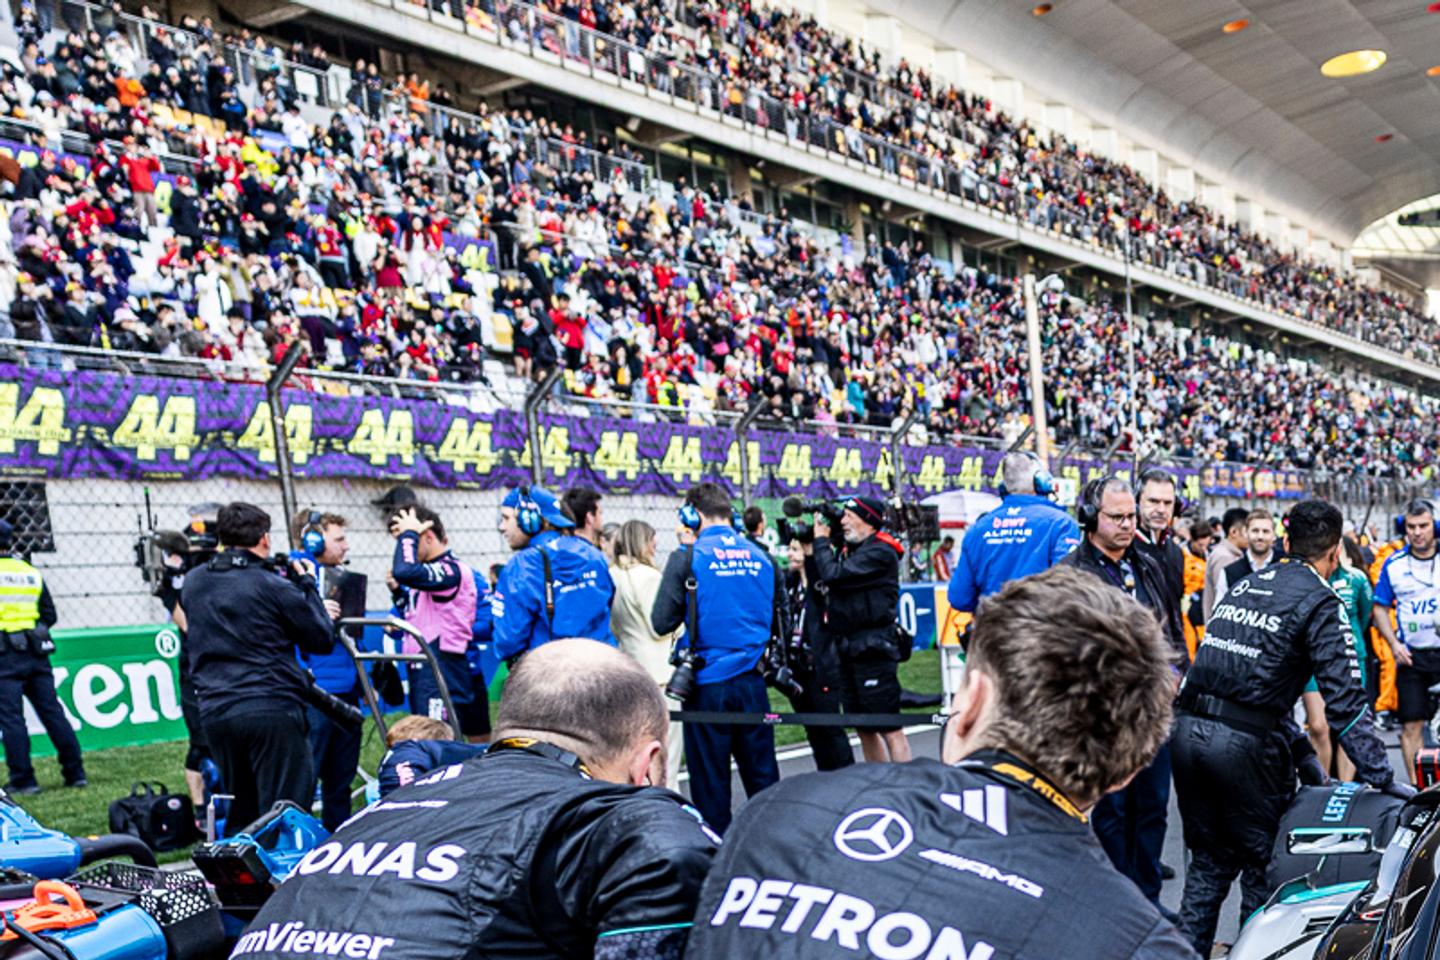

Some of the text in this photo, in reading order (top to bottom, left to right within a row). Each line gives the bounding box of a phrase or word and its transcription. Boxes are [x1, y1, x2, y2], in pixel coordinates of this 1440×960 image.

[112, 394, 202, 461] 44
[347, 409, 416, 466] 44
[439, 417, 497, 474] 44
[593, 431, 640, 480] 44
[662, 435, 703, 483] 44
[778, 443, 812, 487] 44
[829, 448, 863, 488] 44
[1321, 795, 1351, 822] LEFT
[289, 841, 467, 882] ONAS
